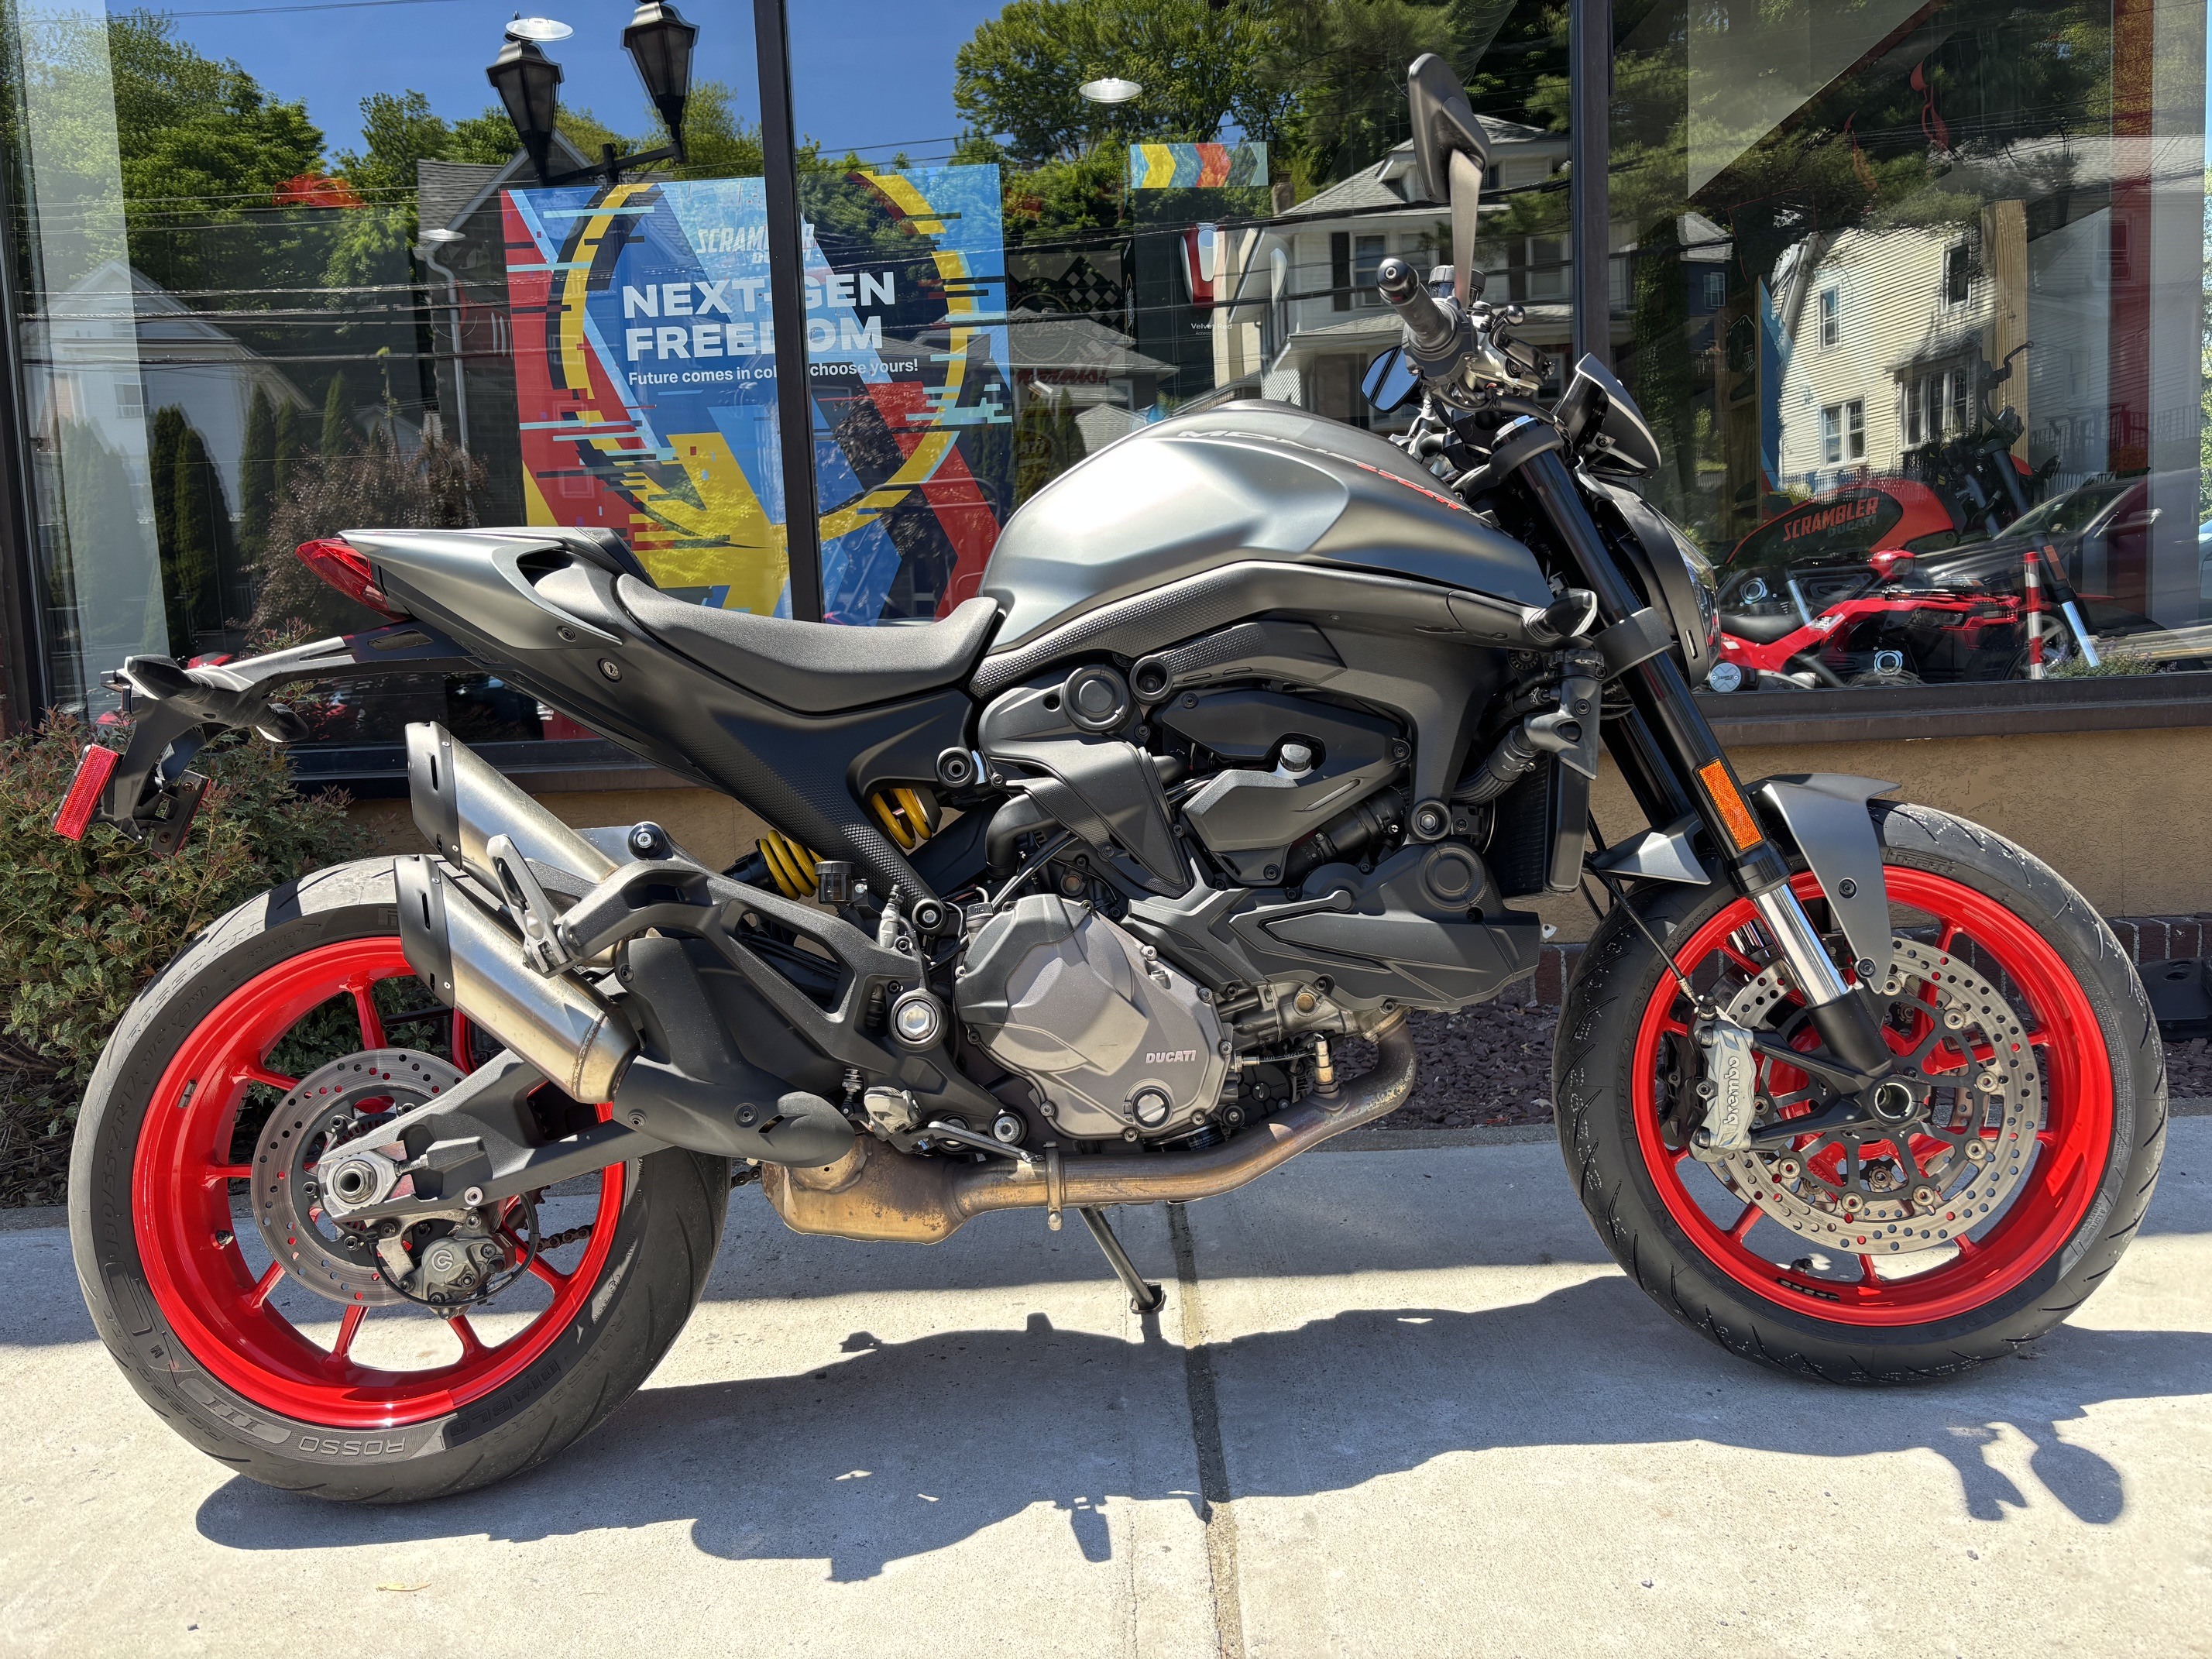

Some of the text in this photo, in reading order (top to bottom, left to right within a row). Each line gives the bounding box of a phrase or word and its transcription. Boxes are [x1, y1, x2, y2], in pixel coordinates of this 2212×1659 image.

[696, 224, 815, 254] SCRAMR
[629, 370, 678, 386] Future
[683, 368, 733, 382] comes
[737, 366, 750, 380] in
[810, 358, 919, 377] choose yours!
[1783, 496, 1879, 541] SCRAMBLER
[1827, 514, 1877, 538] DUCATI
[1146, 1050, 1196, 1063] DUCATI
[1723, 1056, 1740, 1124] brembo
[450, 1361, 562, 1437] DIABLO
[298, 1437, 406, 1456] ROSSO
